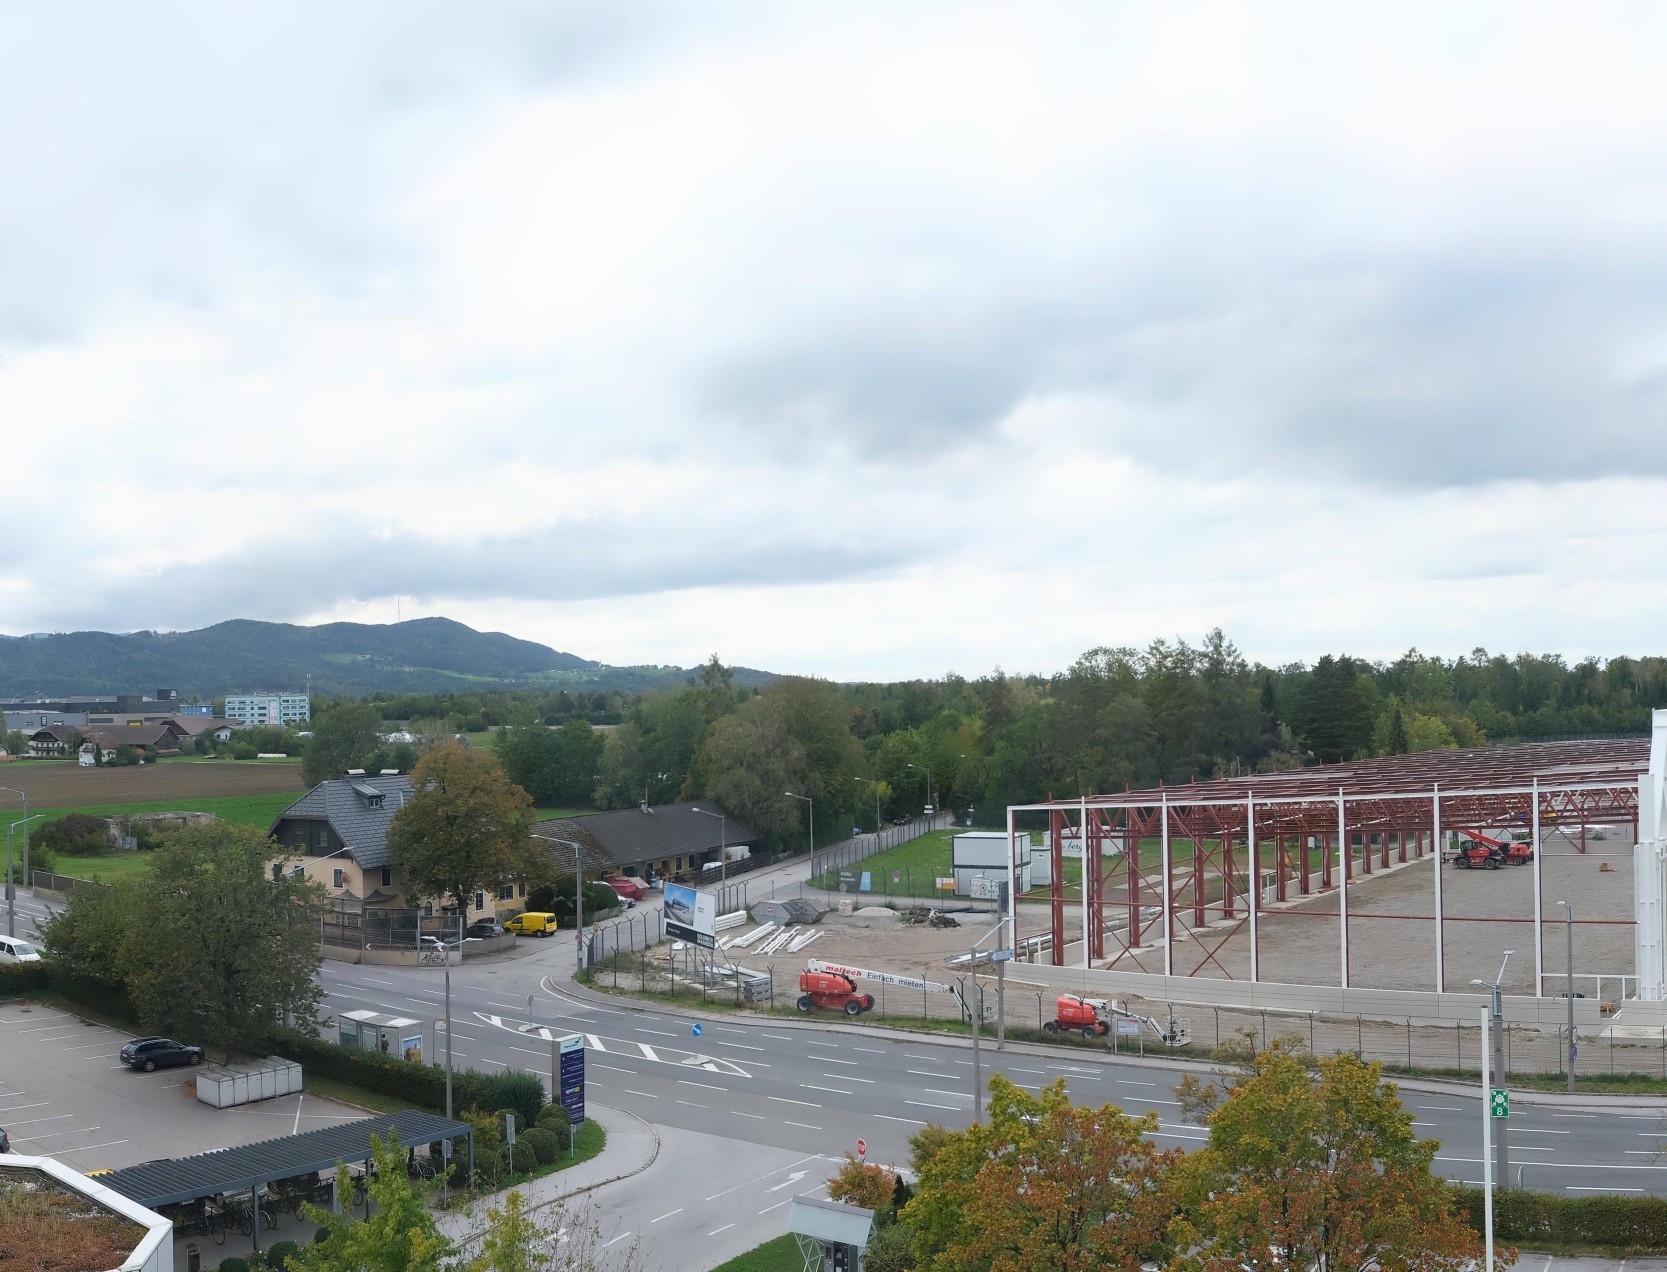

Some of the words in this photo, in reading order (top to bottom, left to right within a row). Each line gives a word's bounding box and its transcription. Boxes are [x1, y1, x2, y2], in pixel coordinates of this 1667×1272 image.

[825, 965, 862, 977] maltech
[867, 972, 895, 983] Einfach
[898, 979, 924, 989] mieten
[1496, 1107, 1503, 1116] 8
